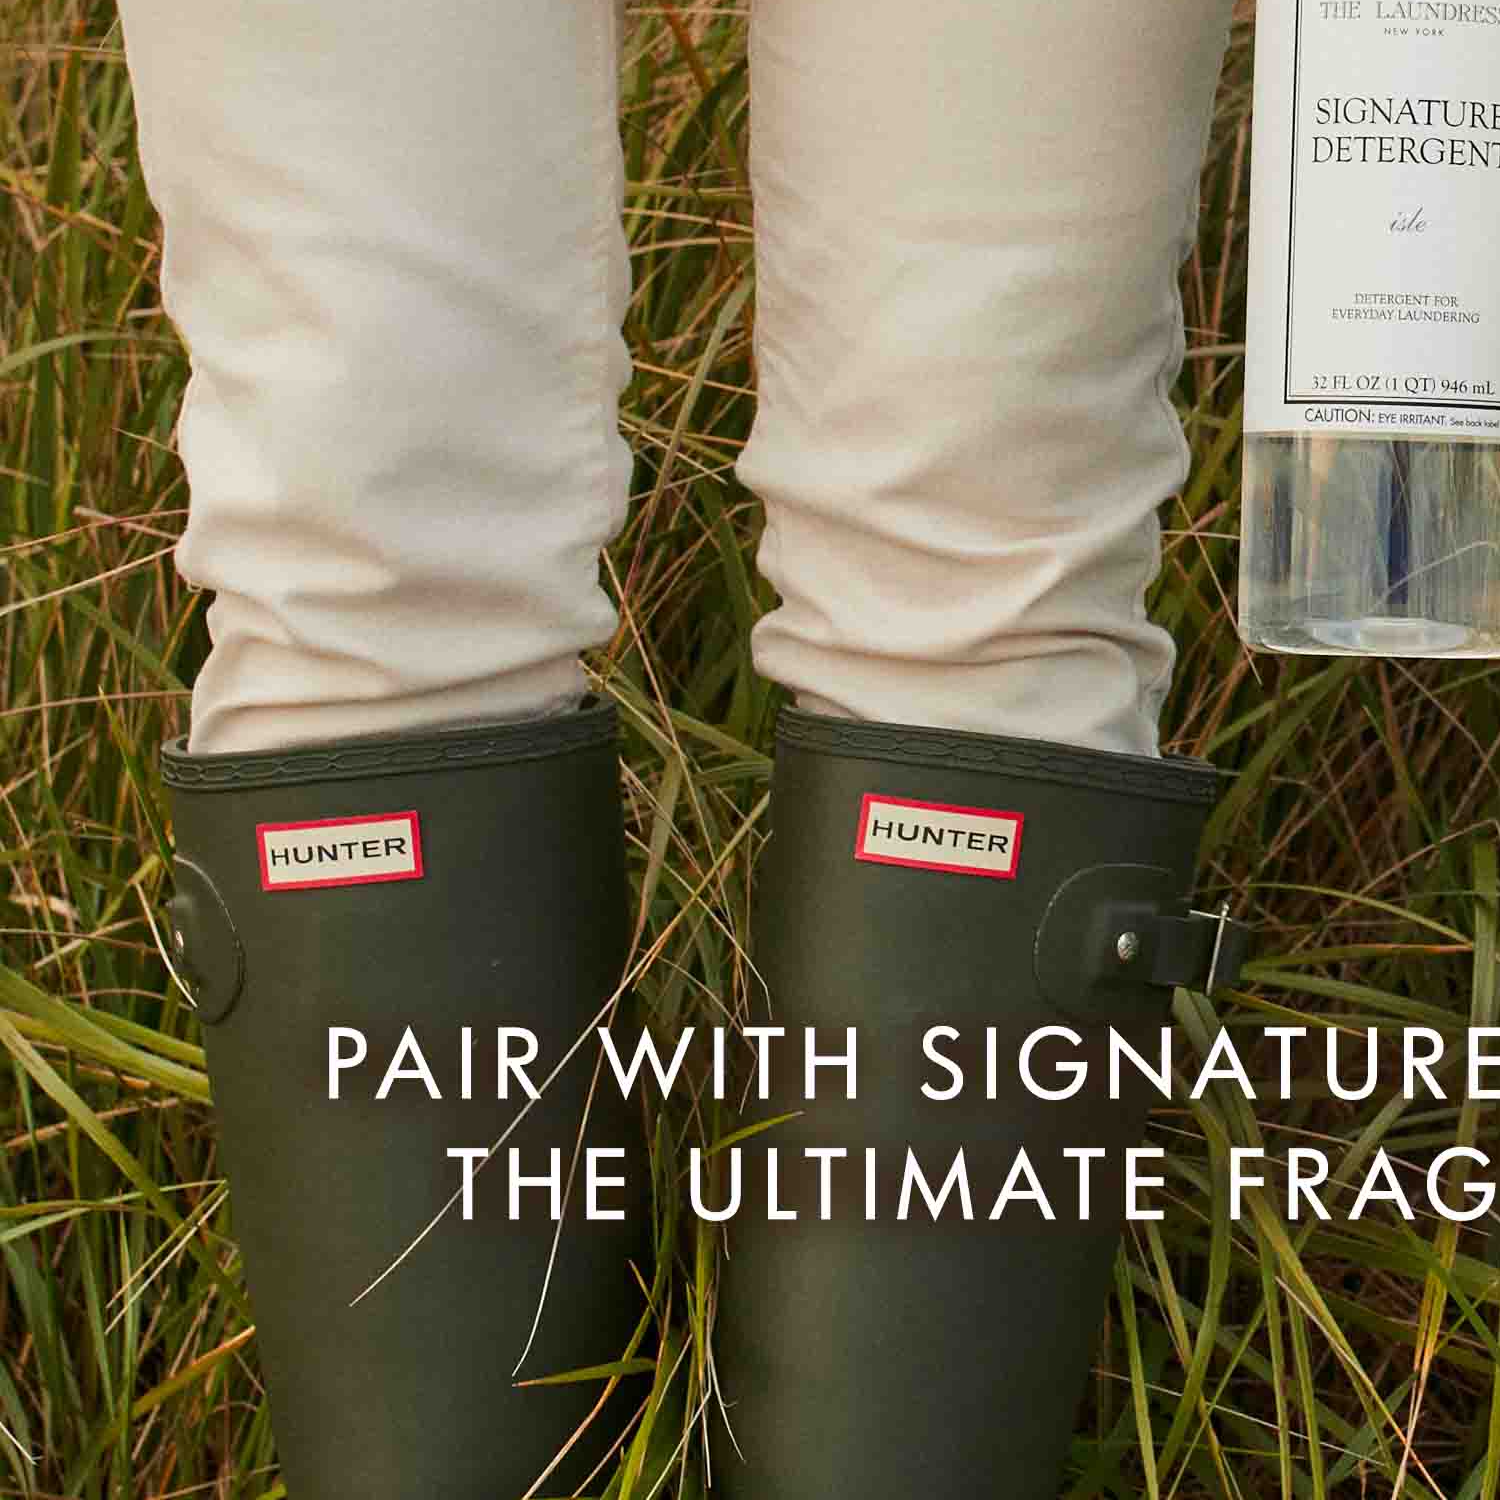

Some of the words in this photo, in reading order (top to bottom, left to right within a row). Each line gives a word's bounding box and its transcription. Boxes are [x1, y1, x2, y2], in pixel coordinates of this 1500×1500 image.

[1319, 1, 1361, 20] THE
[1383, 27, 1408, 37] NEW
[1415, 27, 1445, 37] YORK
[1354, 293, 1430, 306] DETERGENT
[1433, 295, 1459, 307] FOR
[1331, 308, 1394, 321] EVERYDAY
[1398, 309, 1480, 324] LAUNDERING
[1312, 376, 1328, 389] 32
[1333, 376, 1352, 389] FL
[1356, 376, 1380, 390] OZ
[1385, 376, 1398, 391] (1
[1404, 377, 1436, 394] QT)
[1441, 379, 1468, 394] 946
[1304, 408, 1375, 424] CAUTION:
[1378, 413, 1397, 424] EYE
[872, 819, 1009, 854] HUNTER
[271, 837, 406, 866] HUNTER
